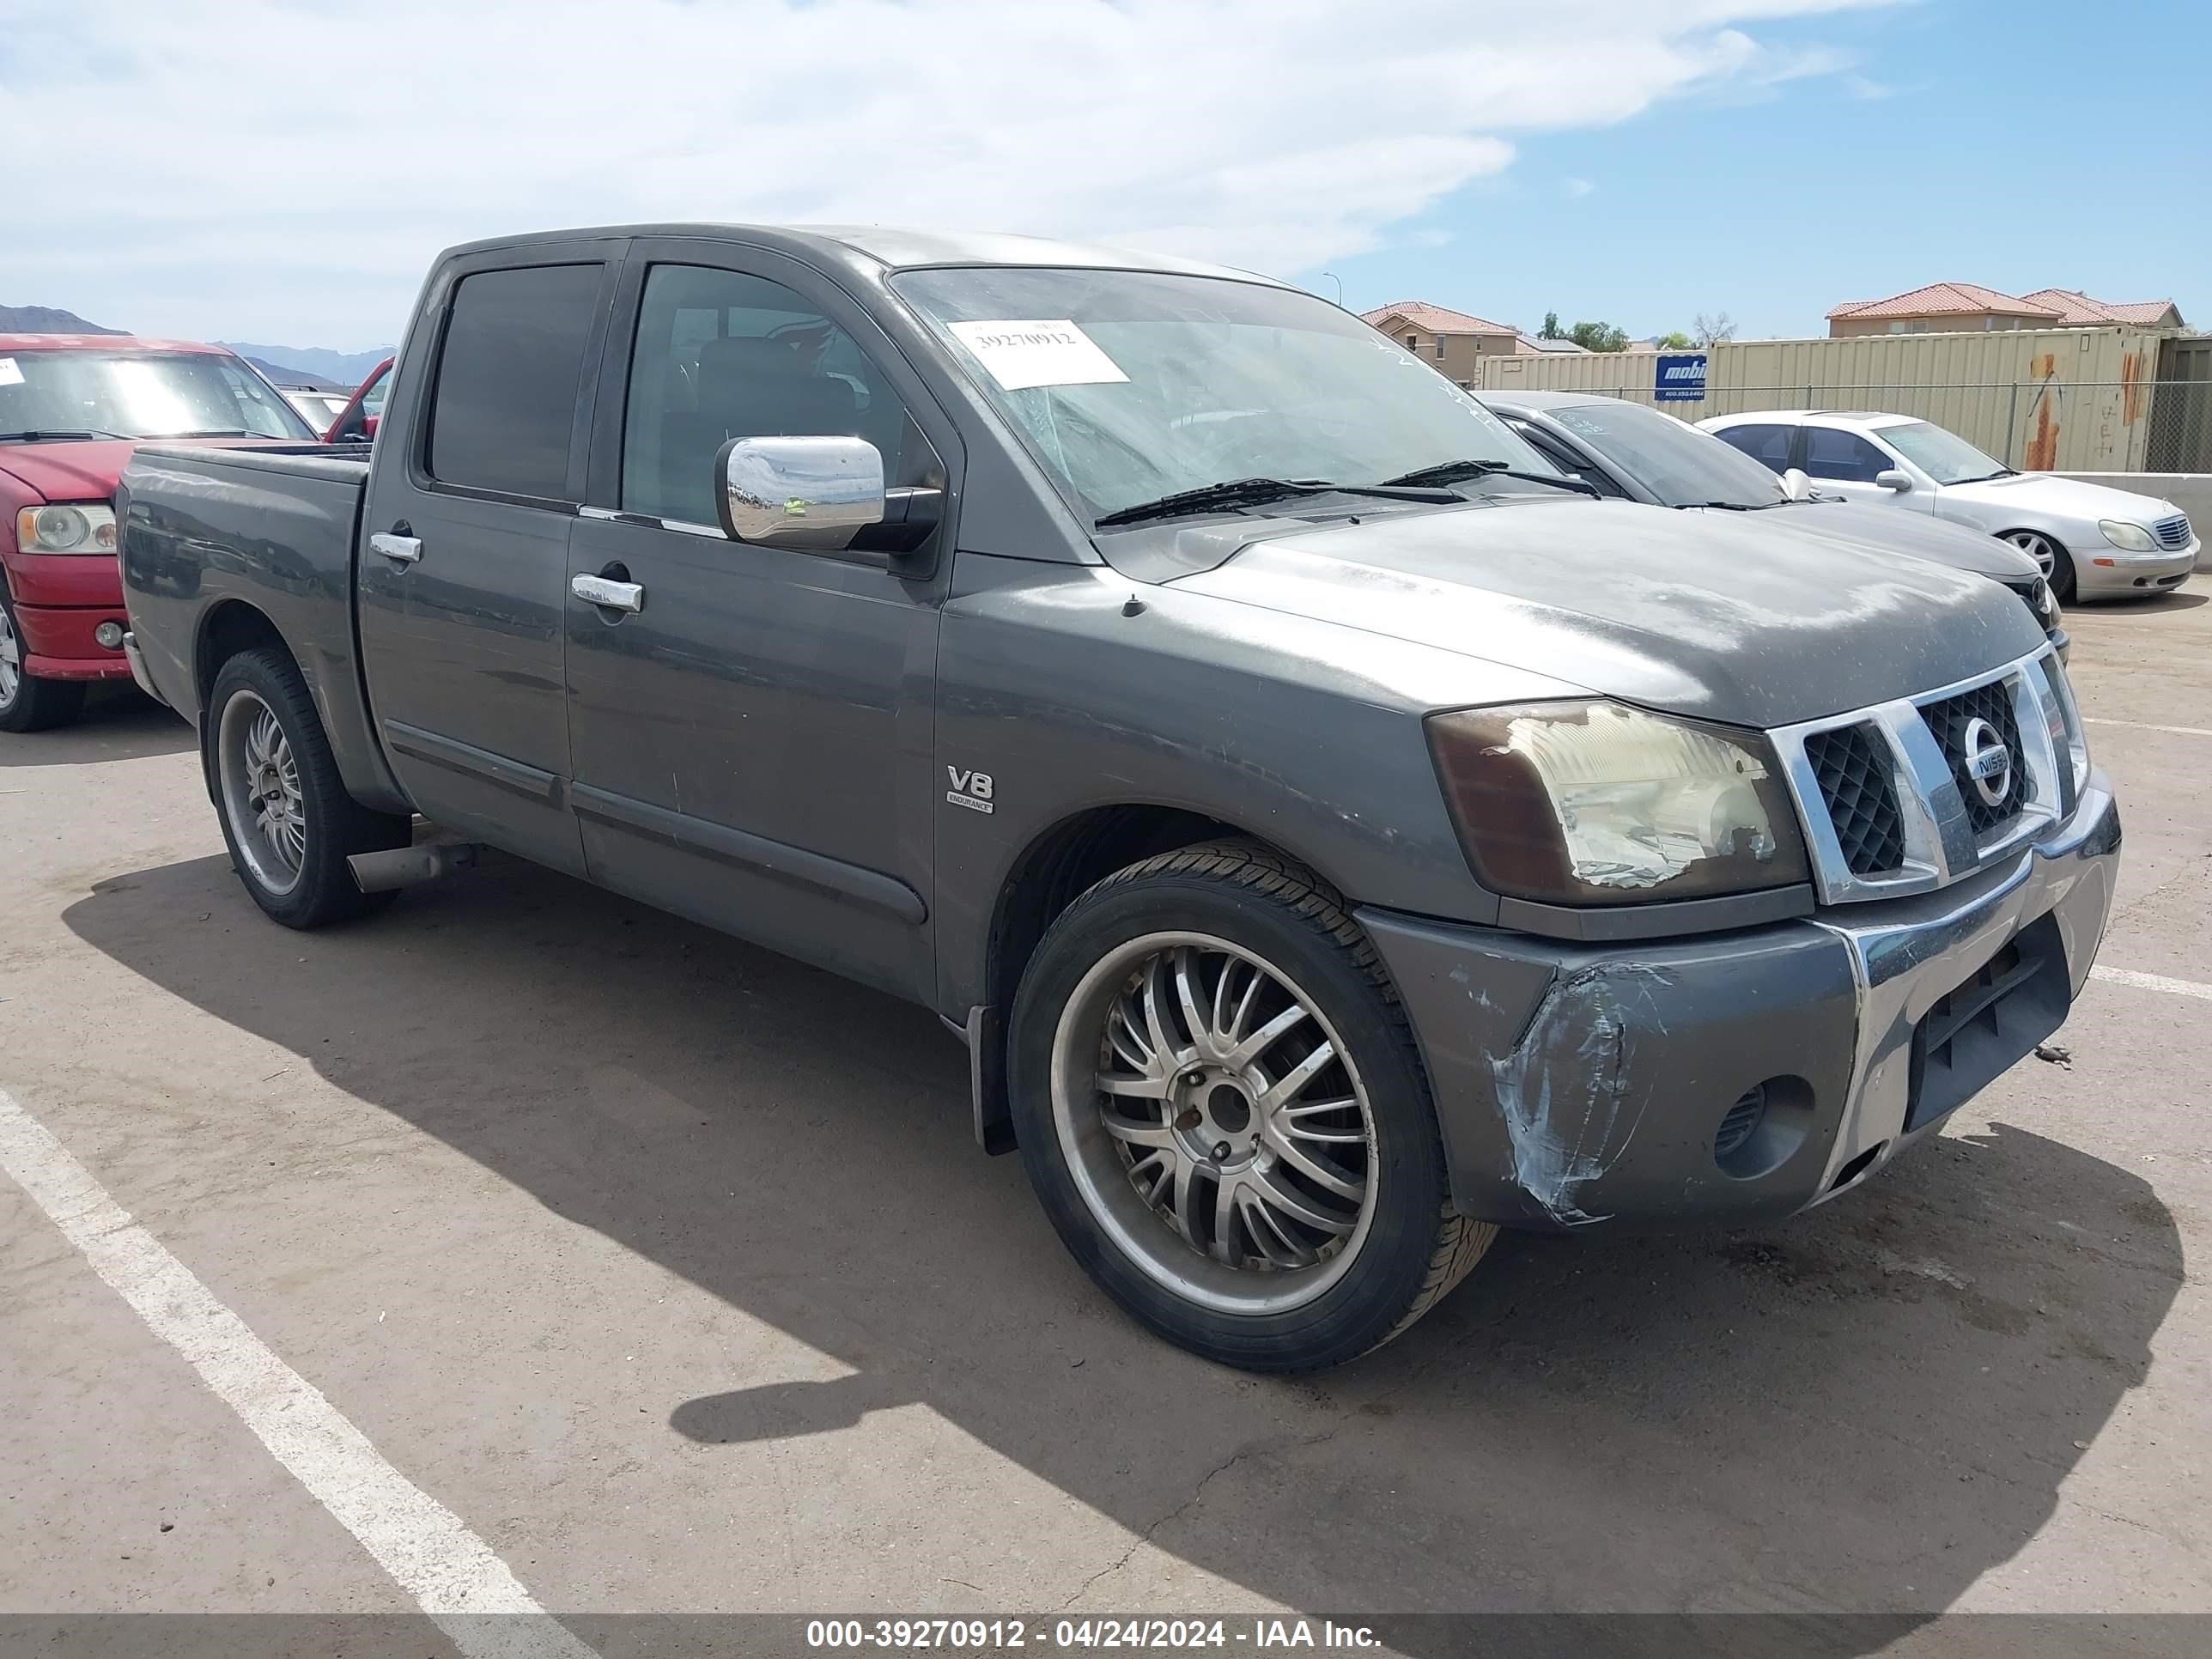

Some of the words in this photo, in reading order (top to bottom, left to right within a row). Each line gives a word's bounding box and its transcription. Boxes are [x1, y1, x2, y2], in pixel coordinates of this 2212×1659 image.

[976, 333, 1076, 348] 39270912
[1664, 361, 1706, 380] mobi
[947, 765, 993, 799] V8
[949, 794, 992, 811] ENDURANCE
